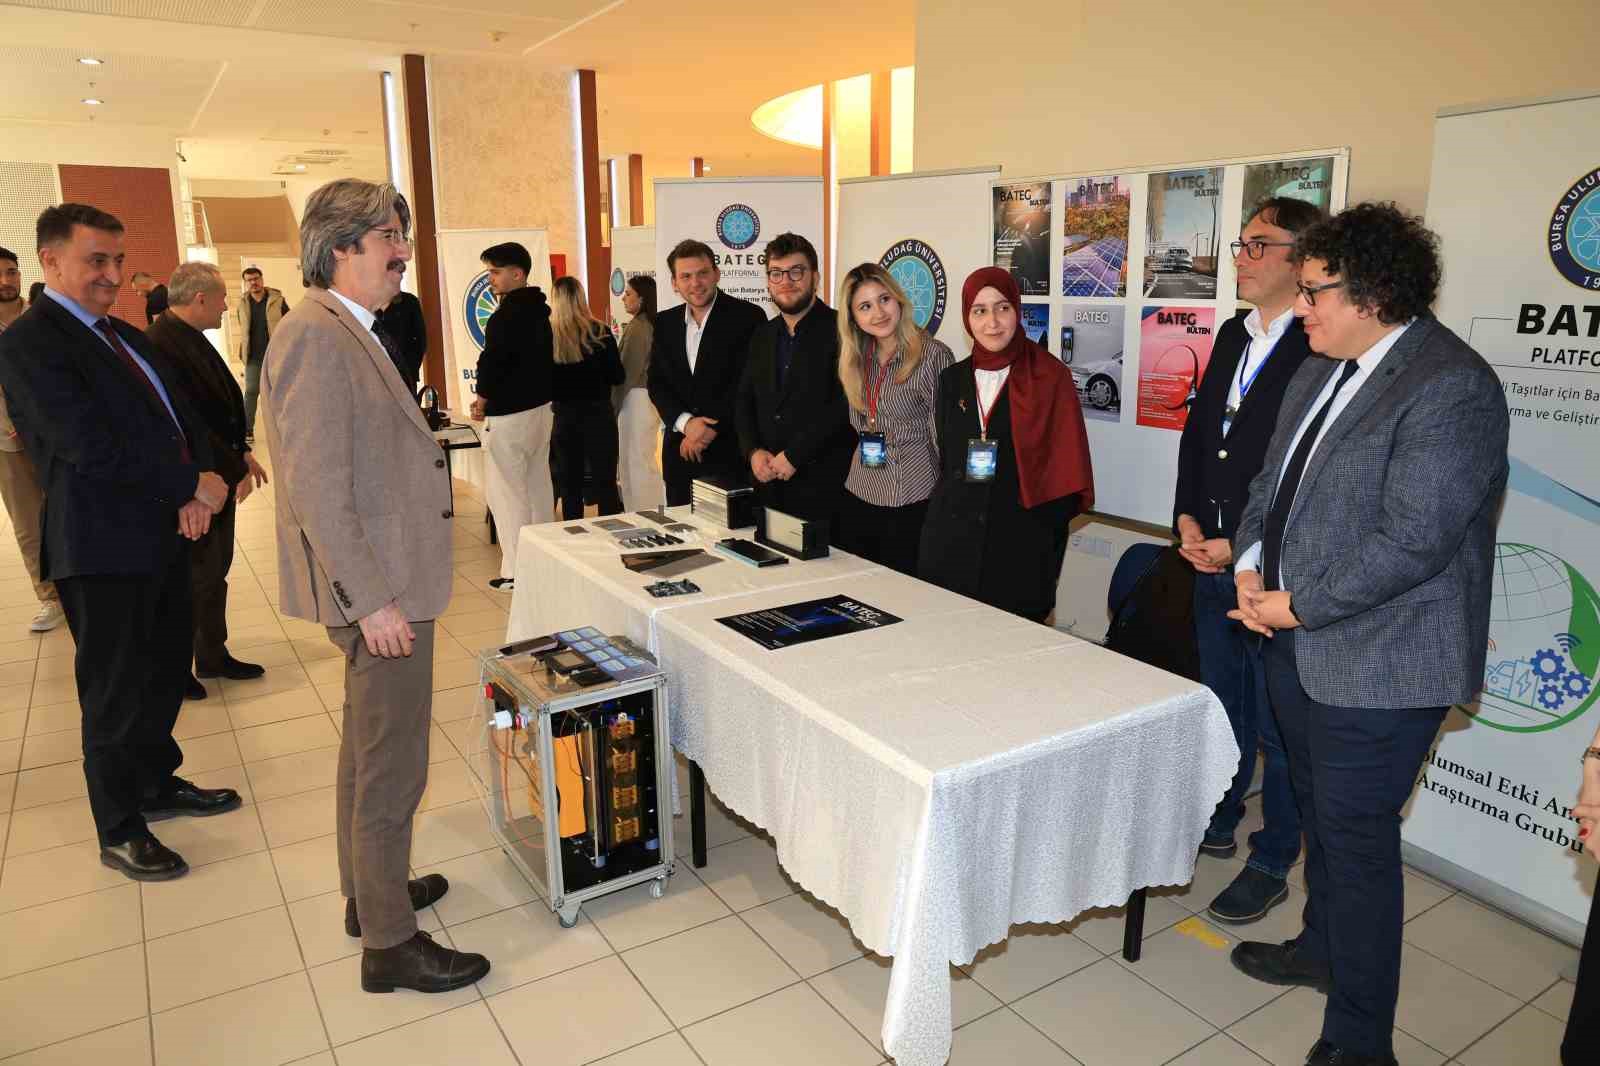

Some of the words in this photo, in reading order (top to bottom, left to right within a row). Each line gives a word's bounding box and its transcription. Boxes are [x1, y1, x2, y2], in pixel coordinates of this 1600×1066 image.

[1000, 189, 1032, 201] BATEG
[1551, 204, 1570, 252] BURSA
[714, 255, 766, 265] BATEG
[1074, 310, 1109, 323] BATEG
[1157, 311, 1197, 326] BATEG
[1187, 325, 1211, 335] BÜLTEN
[1512, 382, 1555, 398] Taşıtlar
[1557, 387, 1581, 401] için
[1536, 410, 1550, 420] ve
[1497, 776, 1540, 806] Etki
[1416, 772, 1510, 823] Araştırma
[1515, 812, 1585, 854] Grubu
